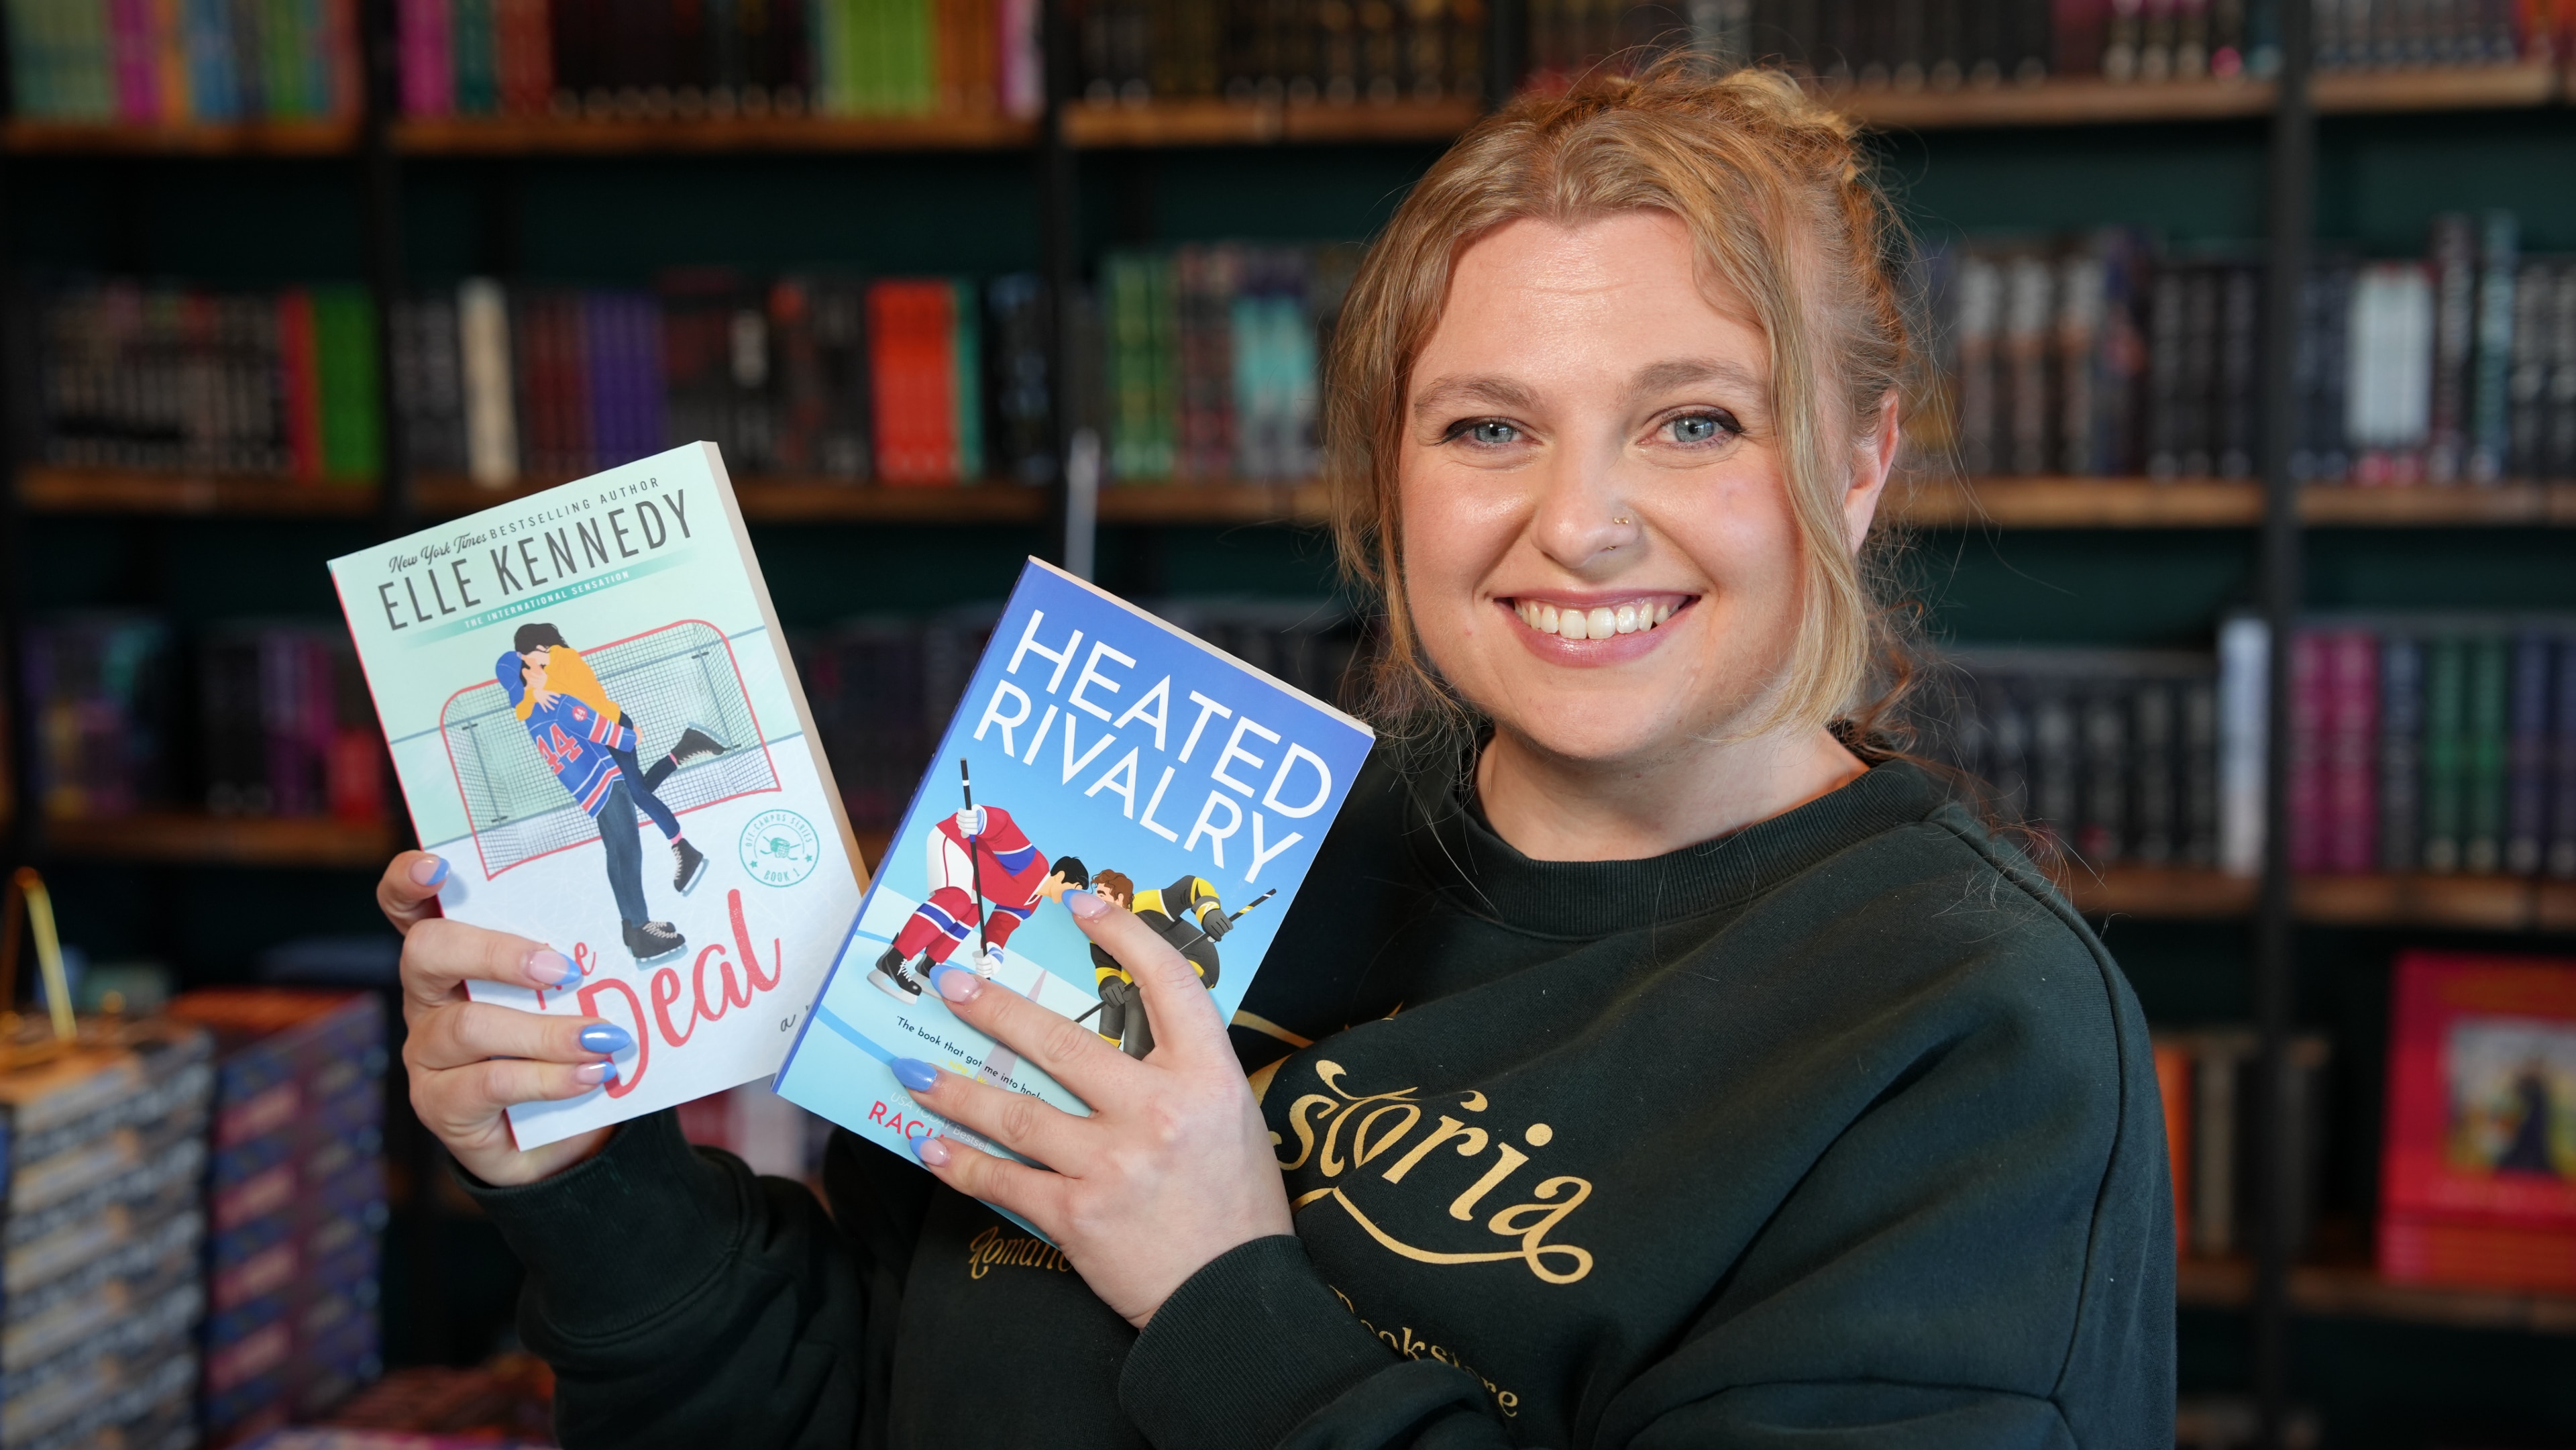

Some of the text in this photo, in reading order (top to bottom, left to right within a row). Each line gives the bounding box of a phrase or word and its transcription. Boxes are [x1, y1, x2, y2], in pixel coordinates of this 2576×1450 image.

[389, 477, 659, 573] New York Times BESTSELLING AUTHOR
[378, 488, 691, 631] ELLE KENNEDY
[464, 570, 629, 629] THE INTERNATIONAL SENSATION
[574, 708, 586, 721] 44
[1006, 609, 1333, 819] HEATED
[536, 723, 584, 775] 44
[973, 679, 1304, 884] RIVALRY
[745, 813, 813, 847] OFF-CAMPUS SERIES
[763, 868, 800, 882] BOOK 1
[576, 888, 782, 1099] Deal
[780, 1014, 796, 1032] a
[917, 1027, 941, 1045] book
[944, 1042, 964, 1057] that
[965, 1055, 983, 1068] got
[984, 1066, 999, 1077] me
[1000, 1073, 1018, 1088] into
[890, 1092, 914, 1110] USA
